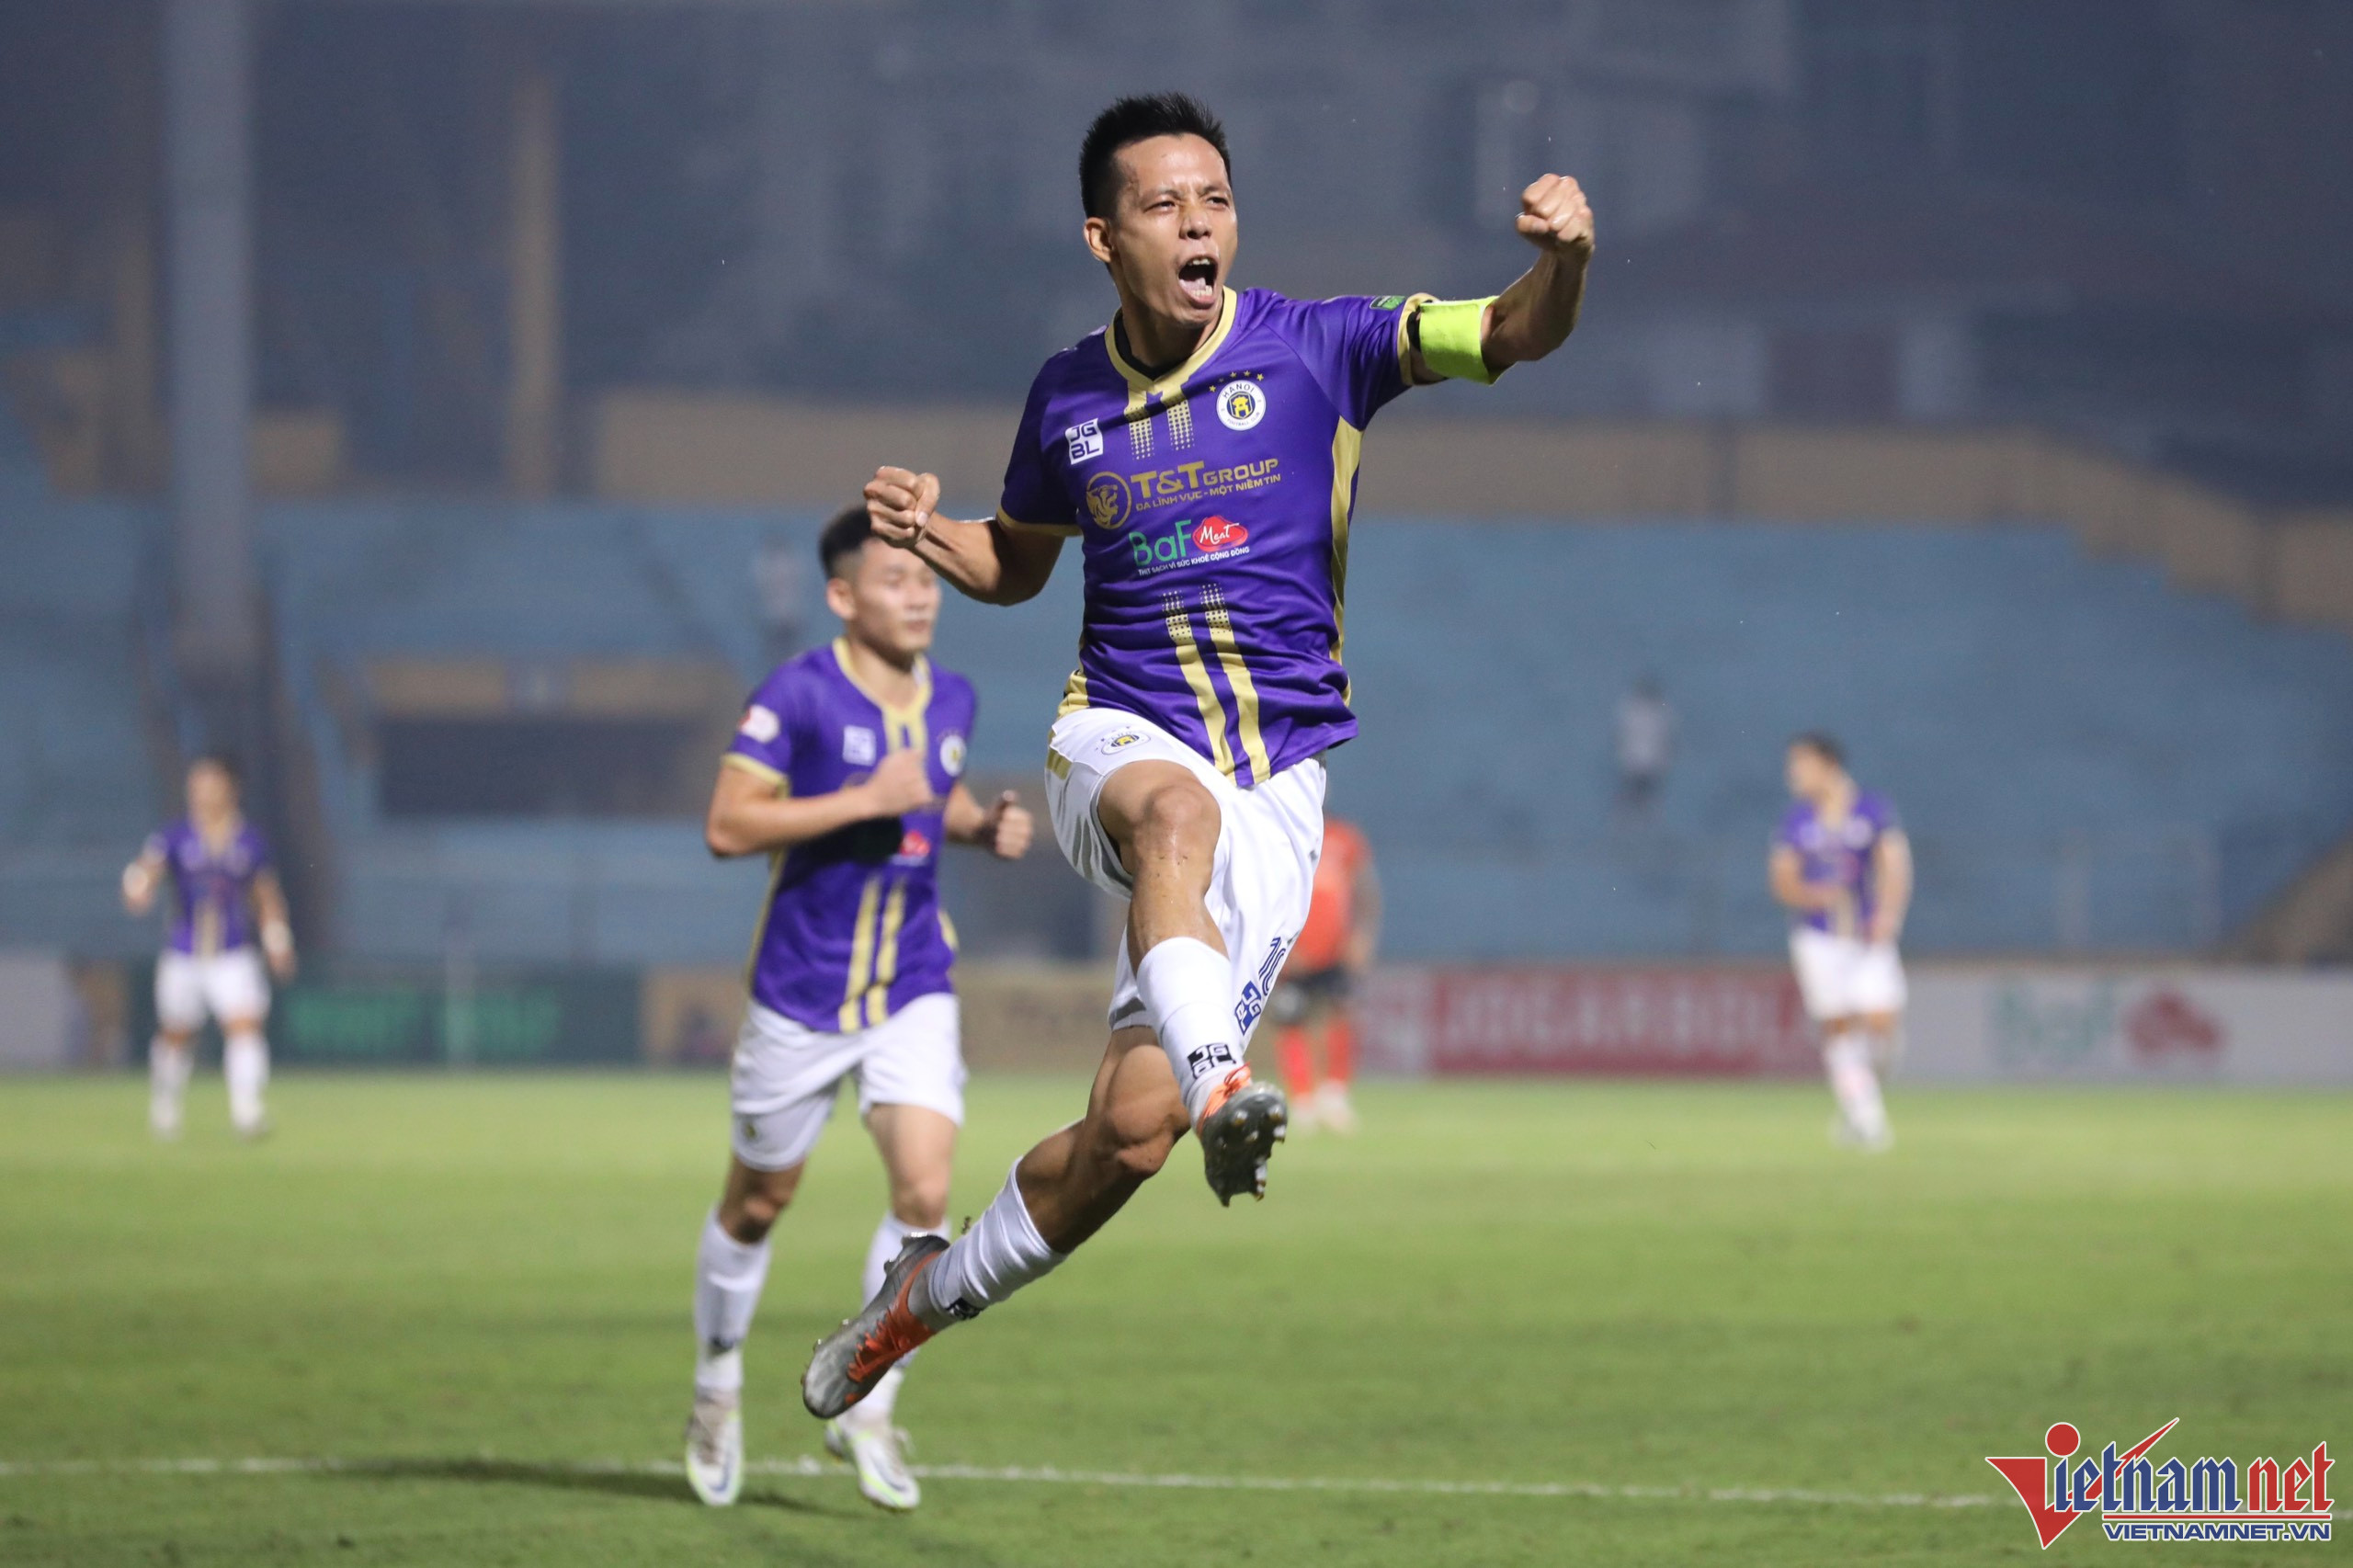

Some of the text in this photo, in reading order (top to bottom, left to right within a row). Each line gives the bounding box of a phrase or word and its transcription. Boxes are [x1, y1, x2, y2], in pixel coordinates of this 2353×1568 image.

[1070, 421, 1097, 442] JG
[1071, 440, 1100, 460] BL
[1131, 458, 1279, 498] T&T GROUP
[1264, 473, 1281, 484] TIN
[1129, 519, 1240, 567] BaF Meat
